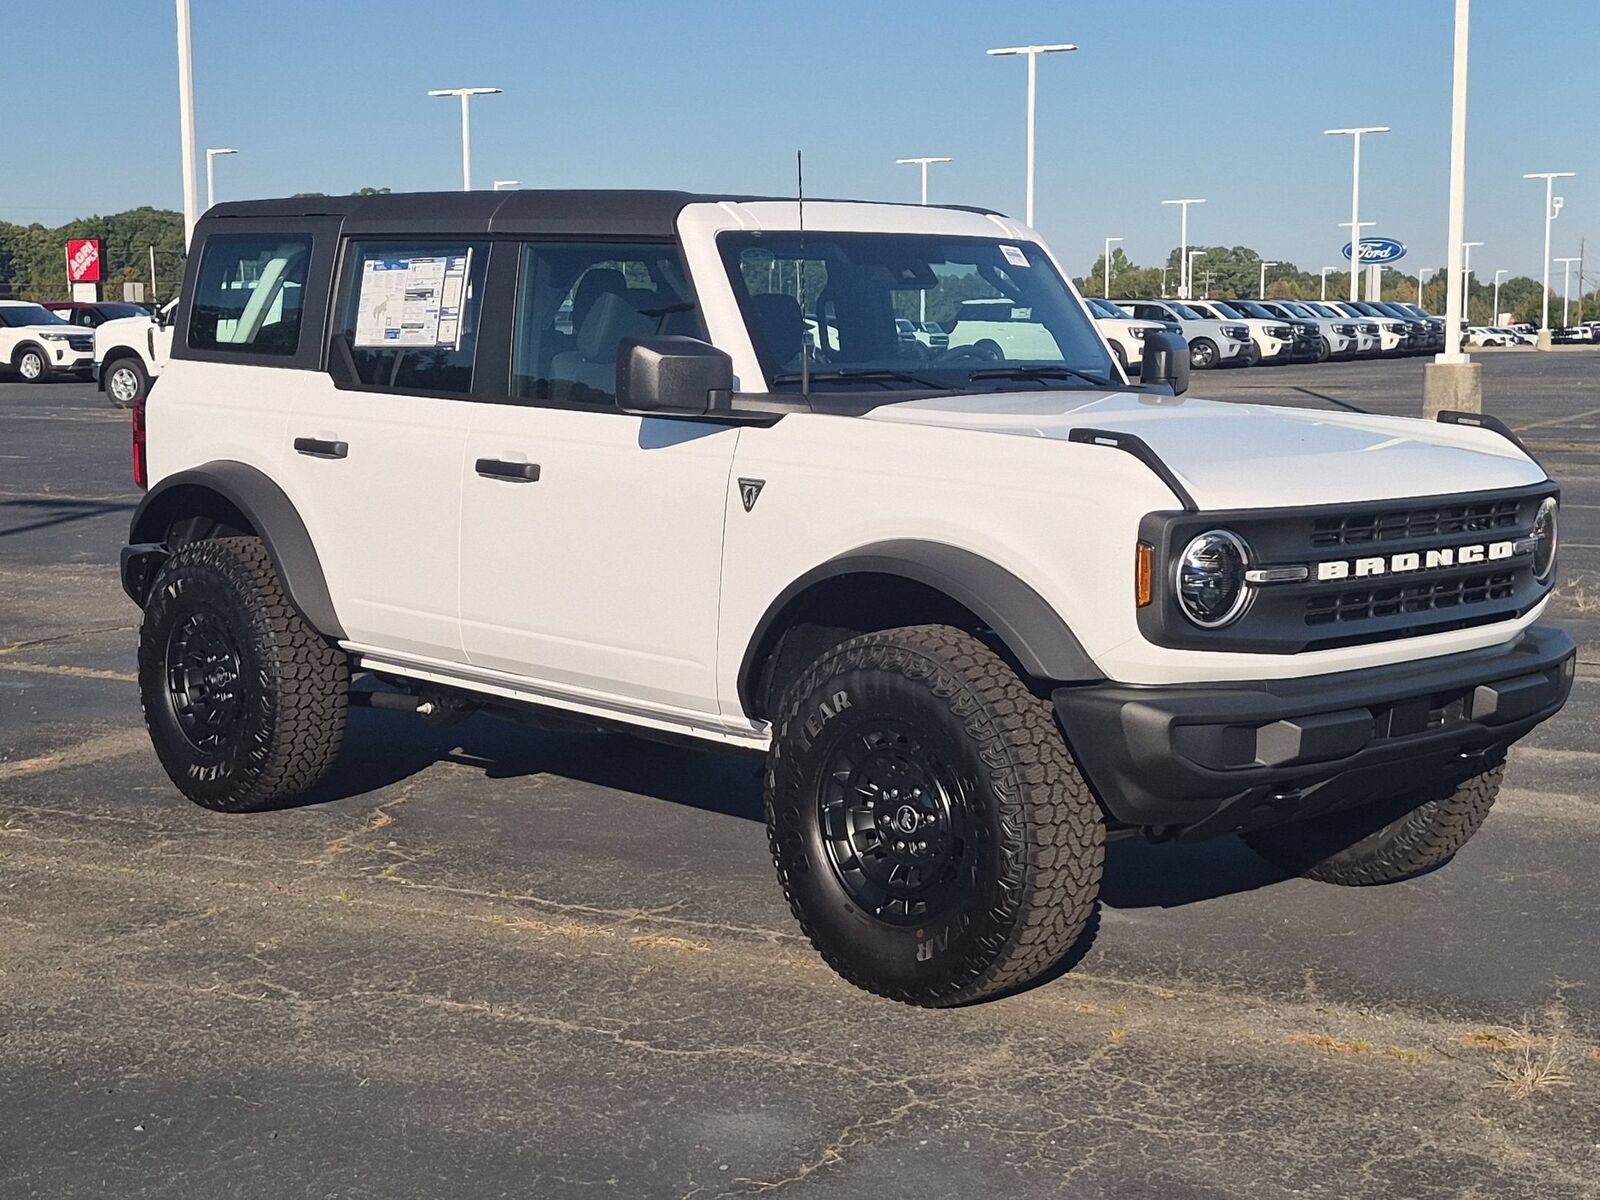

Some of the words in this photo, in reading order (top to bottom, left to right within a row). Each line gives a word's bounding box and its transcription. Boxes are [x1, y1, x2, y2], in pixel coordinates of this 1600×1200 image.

[70, 241, 94, 272] AGRI
[1357, 242, 1392, 258] Ford
[1317, 541, 1513, 581] BRONCO
